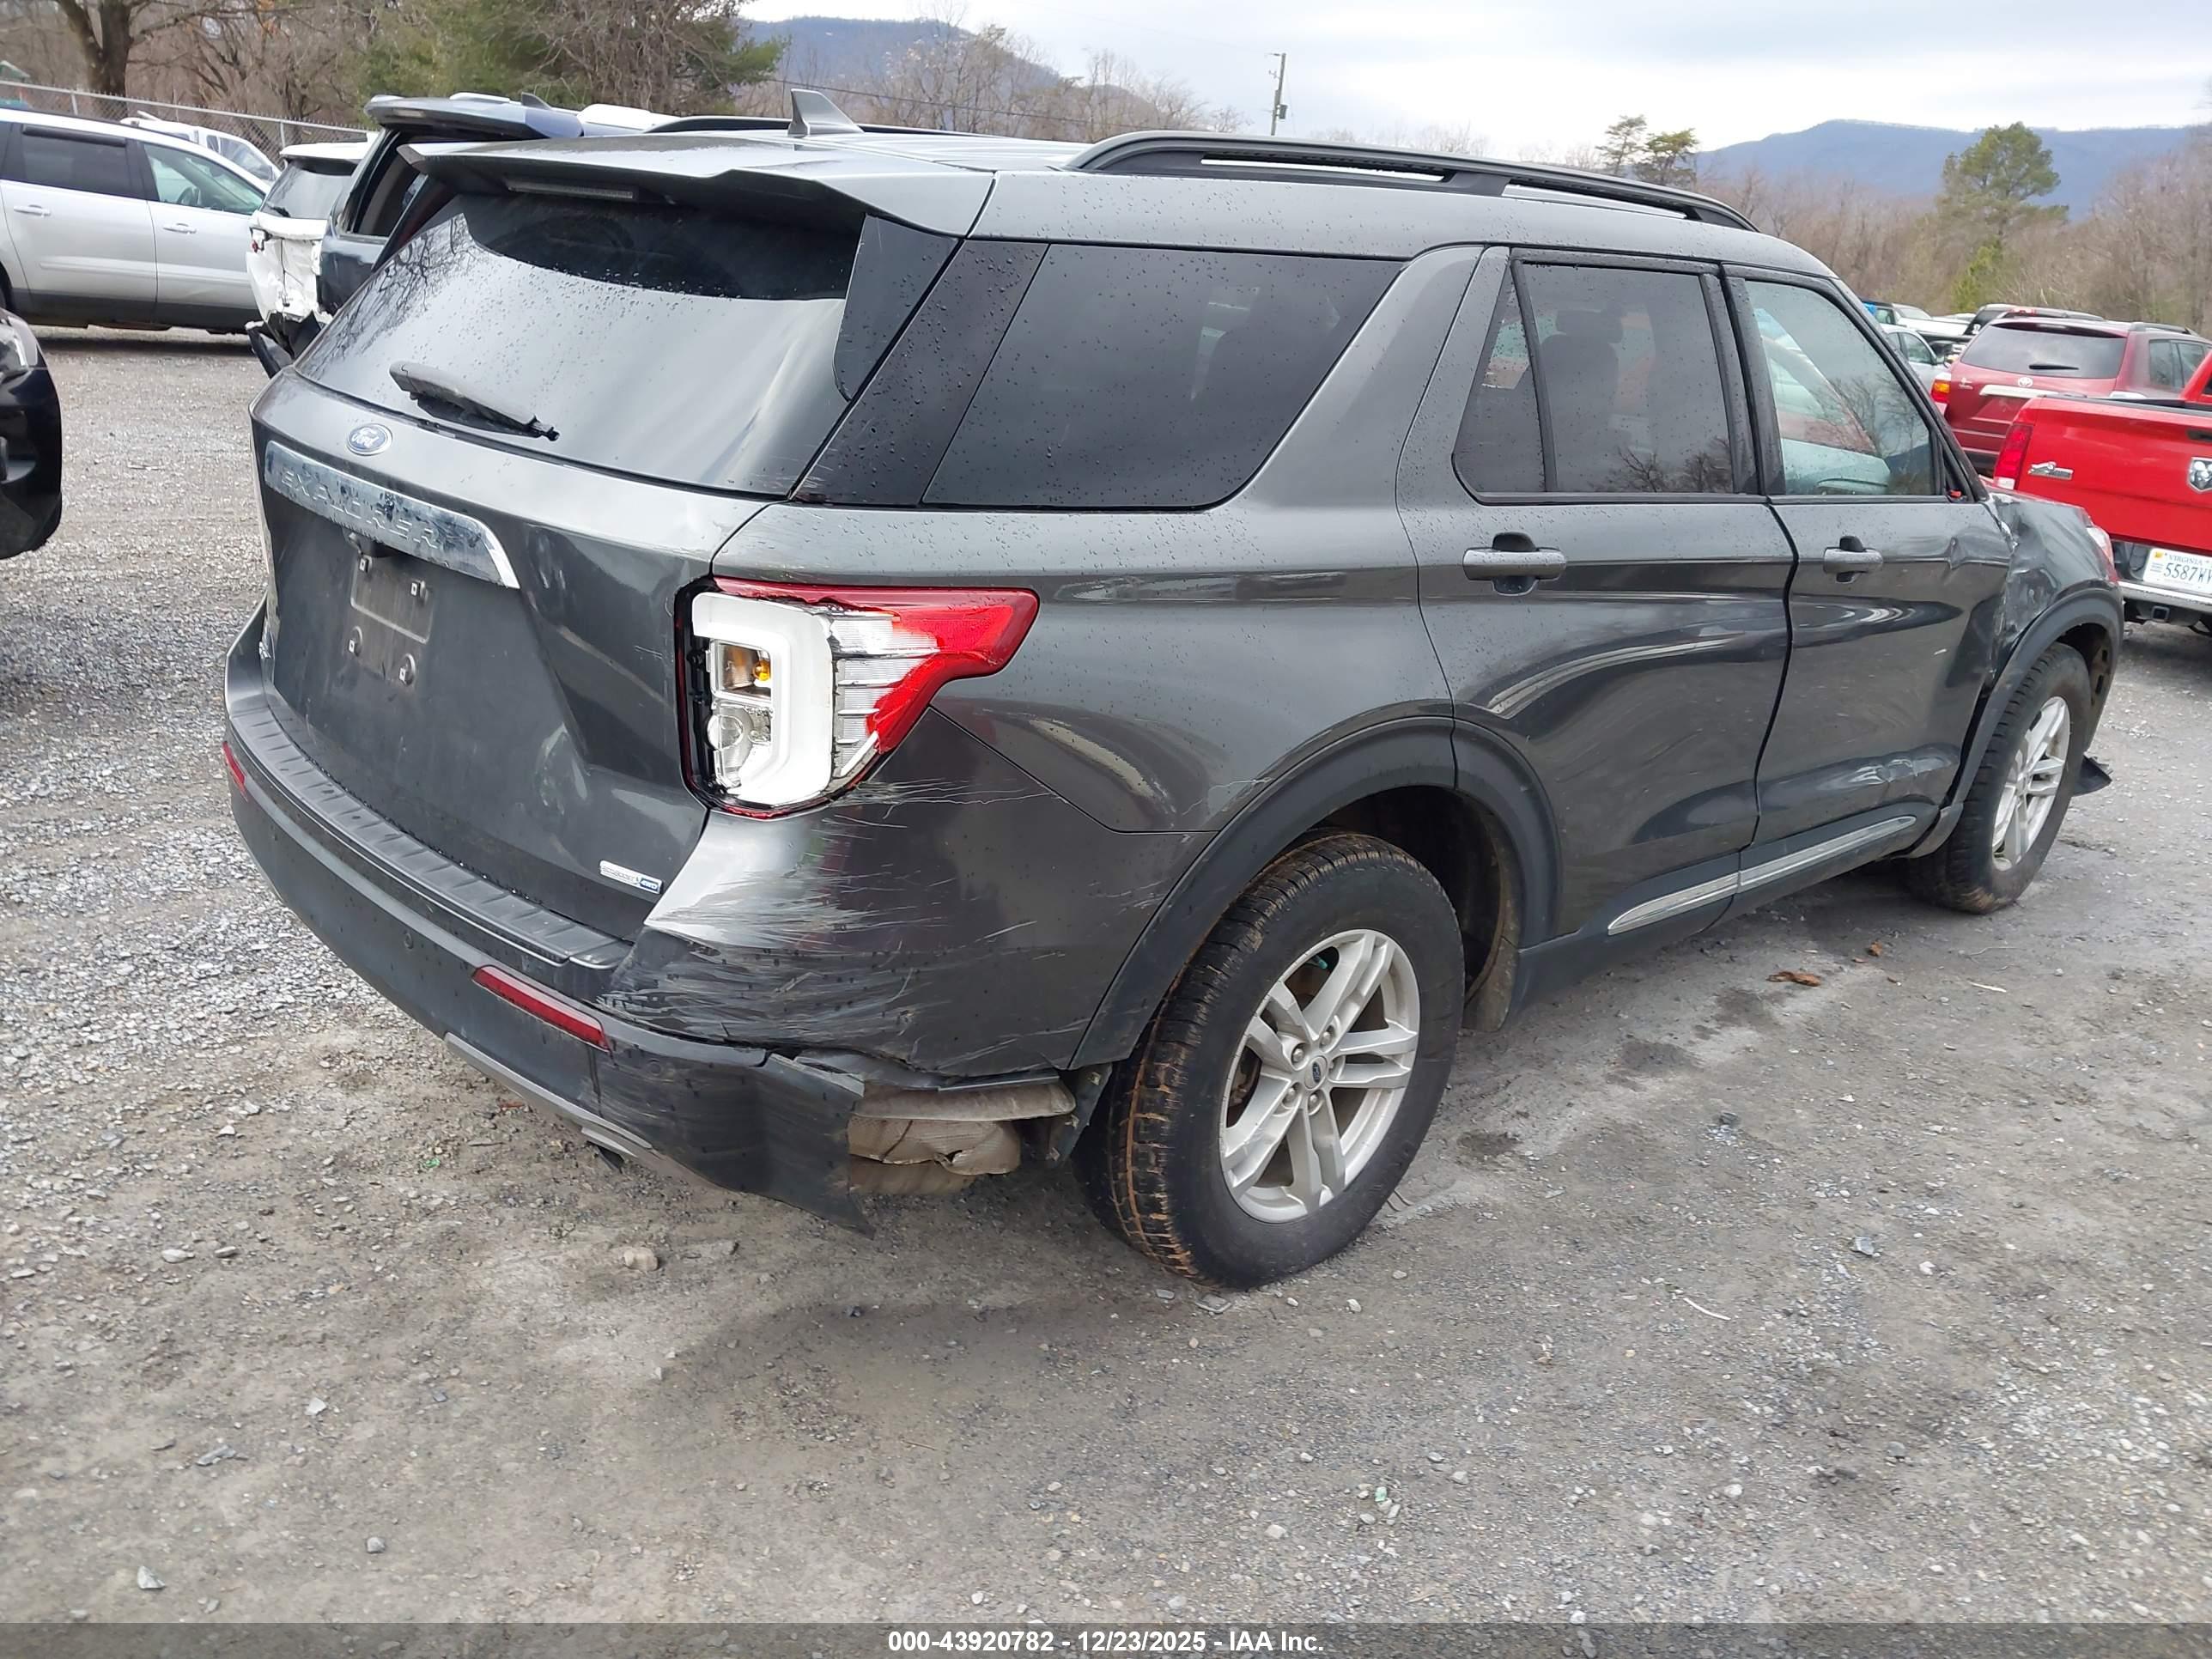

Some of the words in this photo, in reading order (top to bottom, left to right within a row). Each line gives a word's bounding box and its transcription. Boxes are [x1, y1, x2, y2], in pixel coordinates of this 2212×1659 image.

[351, 428, 380, 447] Ford
[281, 471, 439, 550] EXPLORER
[2168, 554, 2203, 567] VIRGINIA
